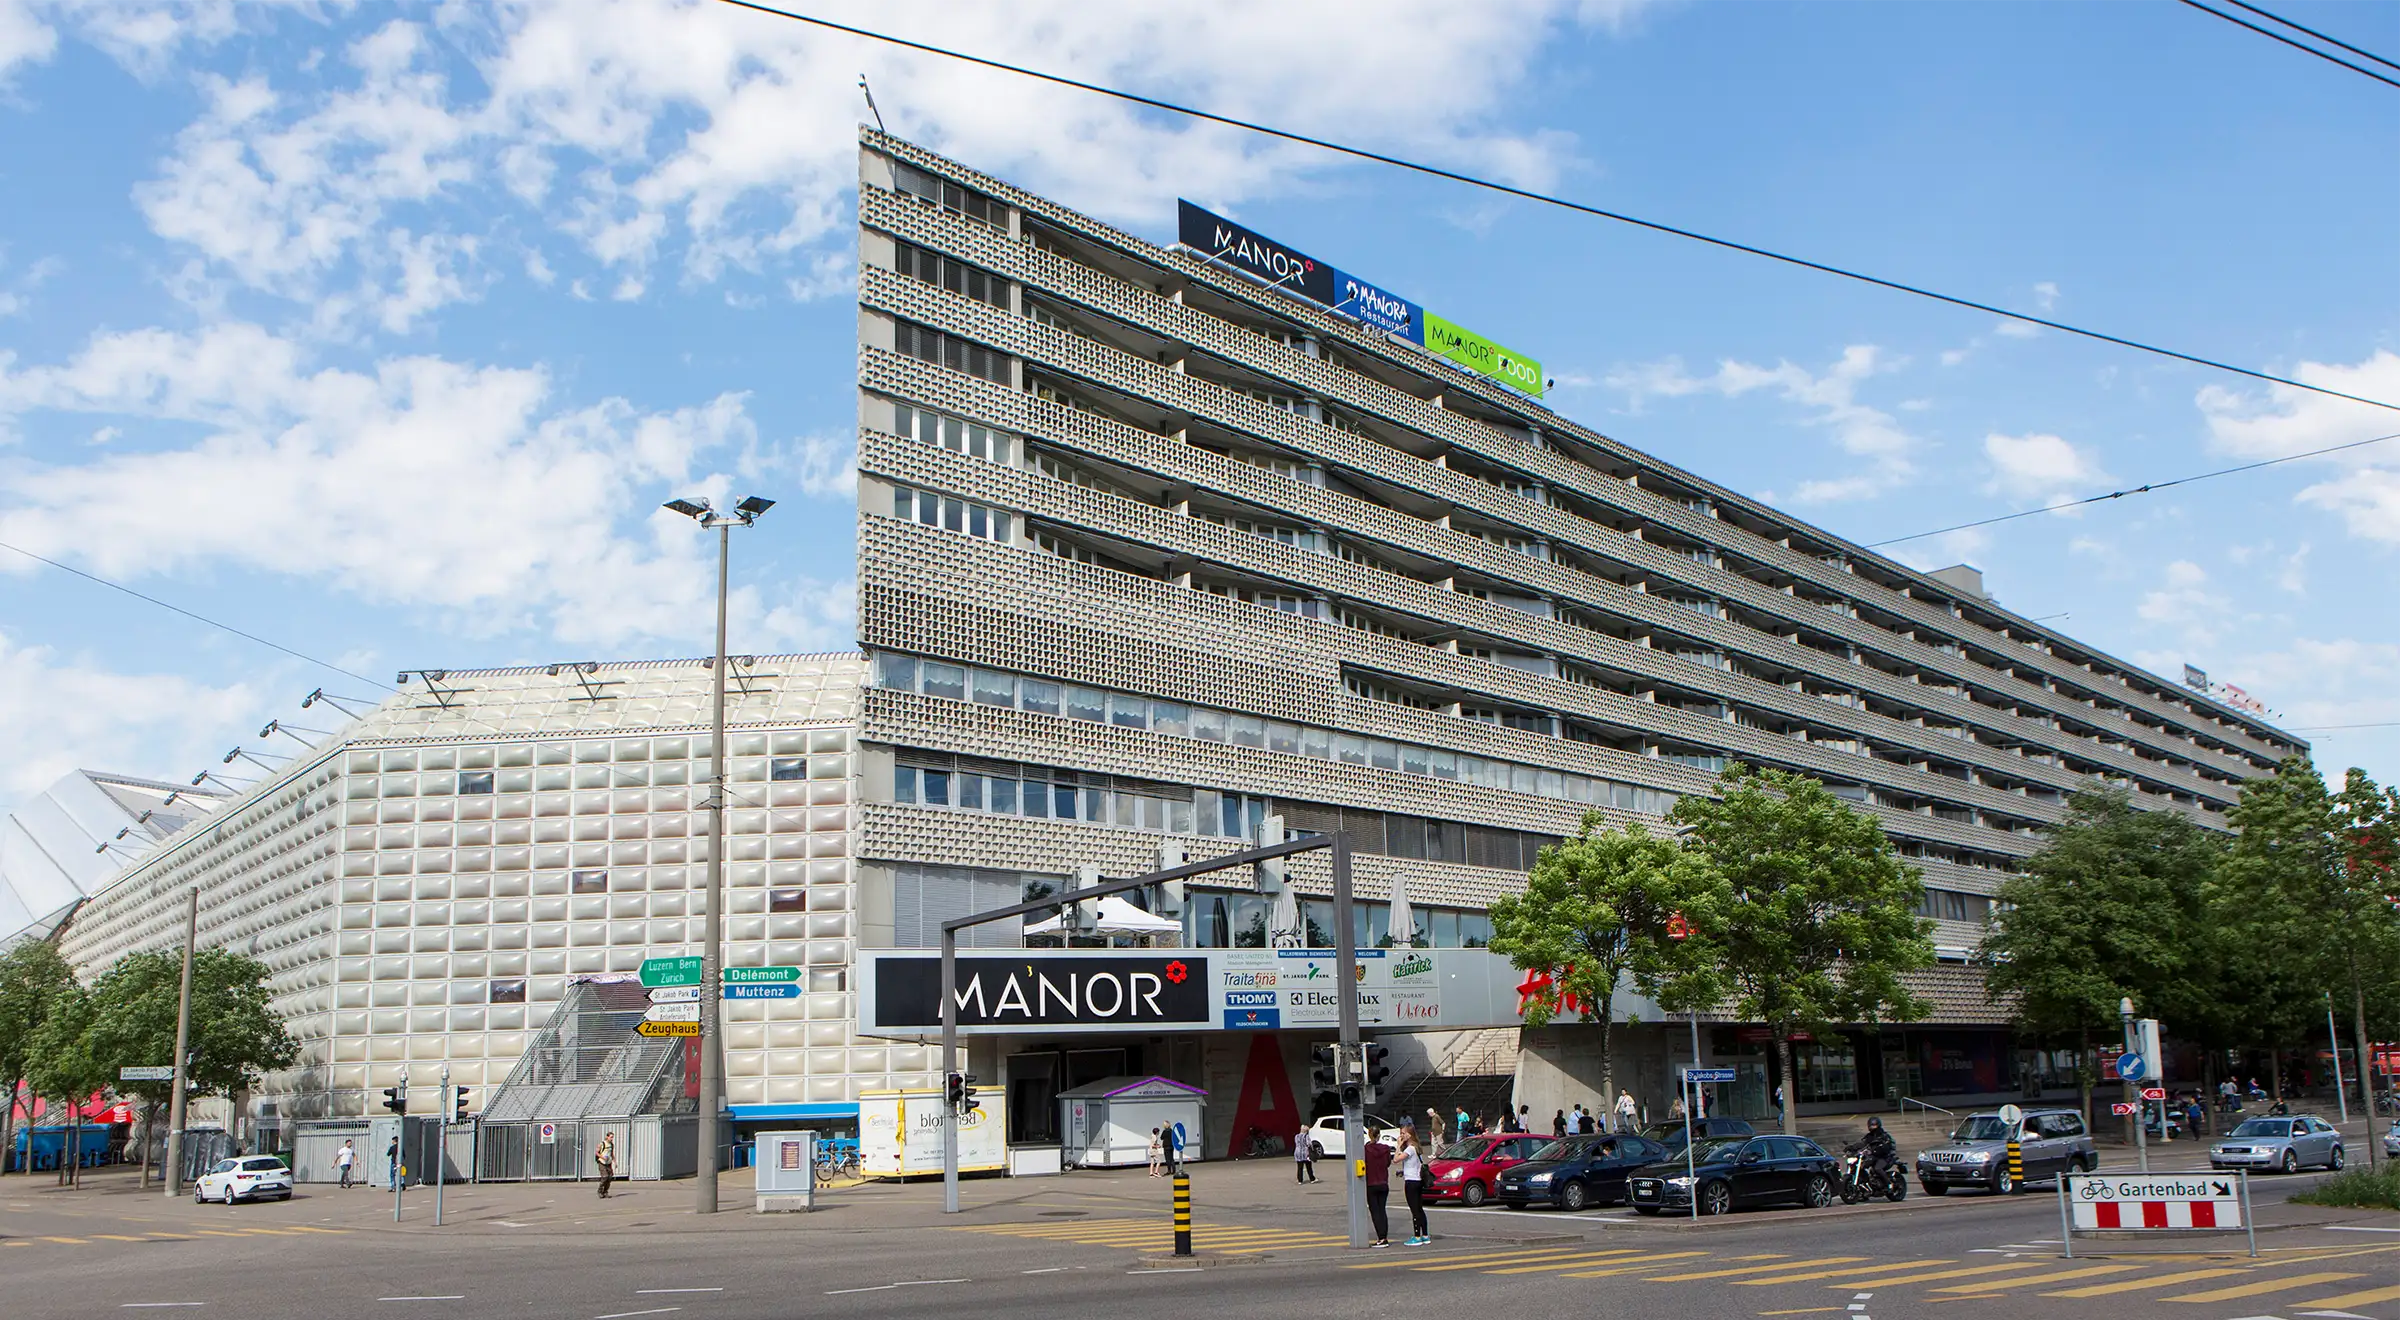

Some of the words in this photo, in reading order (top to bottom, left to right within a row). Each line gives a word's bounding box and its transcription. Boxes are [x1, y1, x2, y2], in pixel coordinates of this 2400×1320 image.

[1213, 223, 1305, 287] MANOR
[1360, 286, 1409, 321] MANORA
[1360, 305, 1410, 337] Restaurant
[1432, 325, 1490, 365] MANOR
[1497, 352, 1537, 386] FOOD
[649, 960, 674, 971] Luzern
[679, 959, 697, 970] Bern
[1393, 957, 1432, 978] Hattrick
[660, 972, 685, 984] Zürich
[731, 969, 789, 980] Delémont
[1223, 972, 1276, 986] Traitafina
[662, 990, 677, 999] Jakob
[678, 989, 690, 998] Park
[735, 986, 785, 997] Muttenz
[937, 972, 1163, 1019] MANOR
[1228, 993, 1274, 1004] THOMY
[683, 1003, 694, 1012] Park
[644, 1022, 697, 1036] Zeughaus
[2118, 1180, 2208, 1198] Gartenbad
